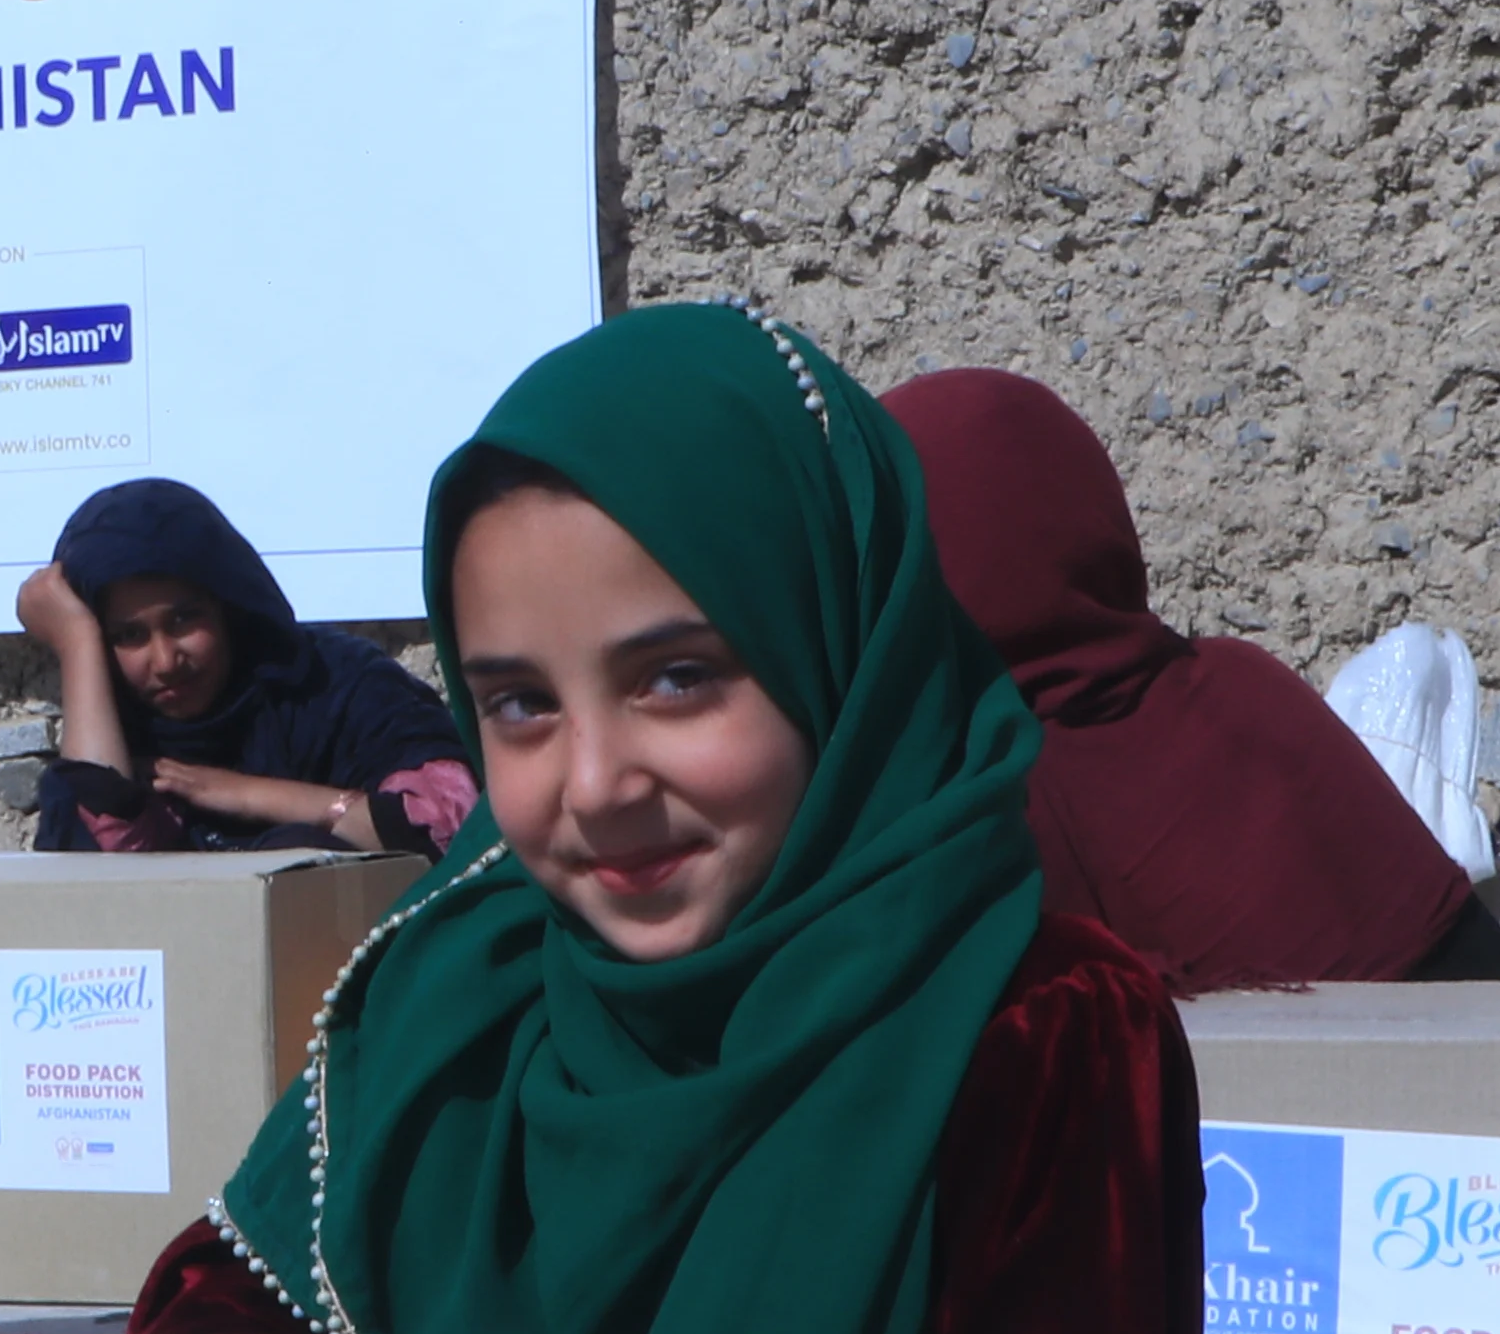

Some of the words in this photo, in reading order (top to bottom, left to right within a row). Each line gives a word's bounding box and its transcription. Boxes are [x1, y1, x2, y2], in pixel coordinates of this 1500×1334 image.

[24, 375, 88, 391] CHANNEL
[91, 373, 112, 386] 741
[12, 965, 153, 1032] Blessed
[25, 1064, 81, 1081] FOOD
[88, 1065, 142, 1082] PACK
[26, 1084, 145, 1099] DISTRIBUTION
[37, 1107, 131, 1121] AFGHANISTAN
[1206, 1305, 1319, 1332] DATION
